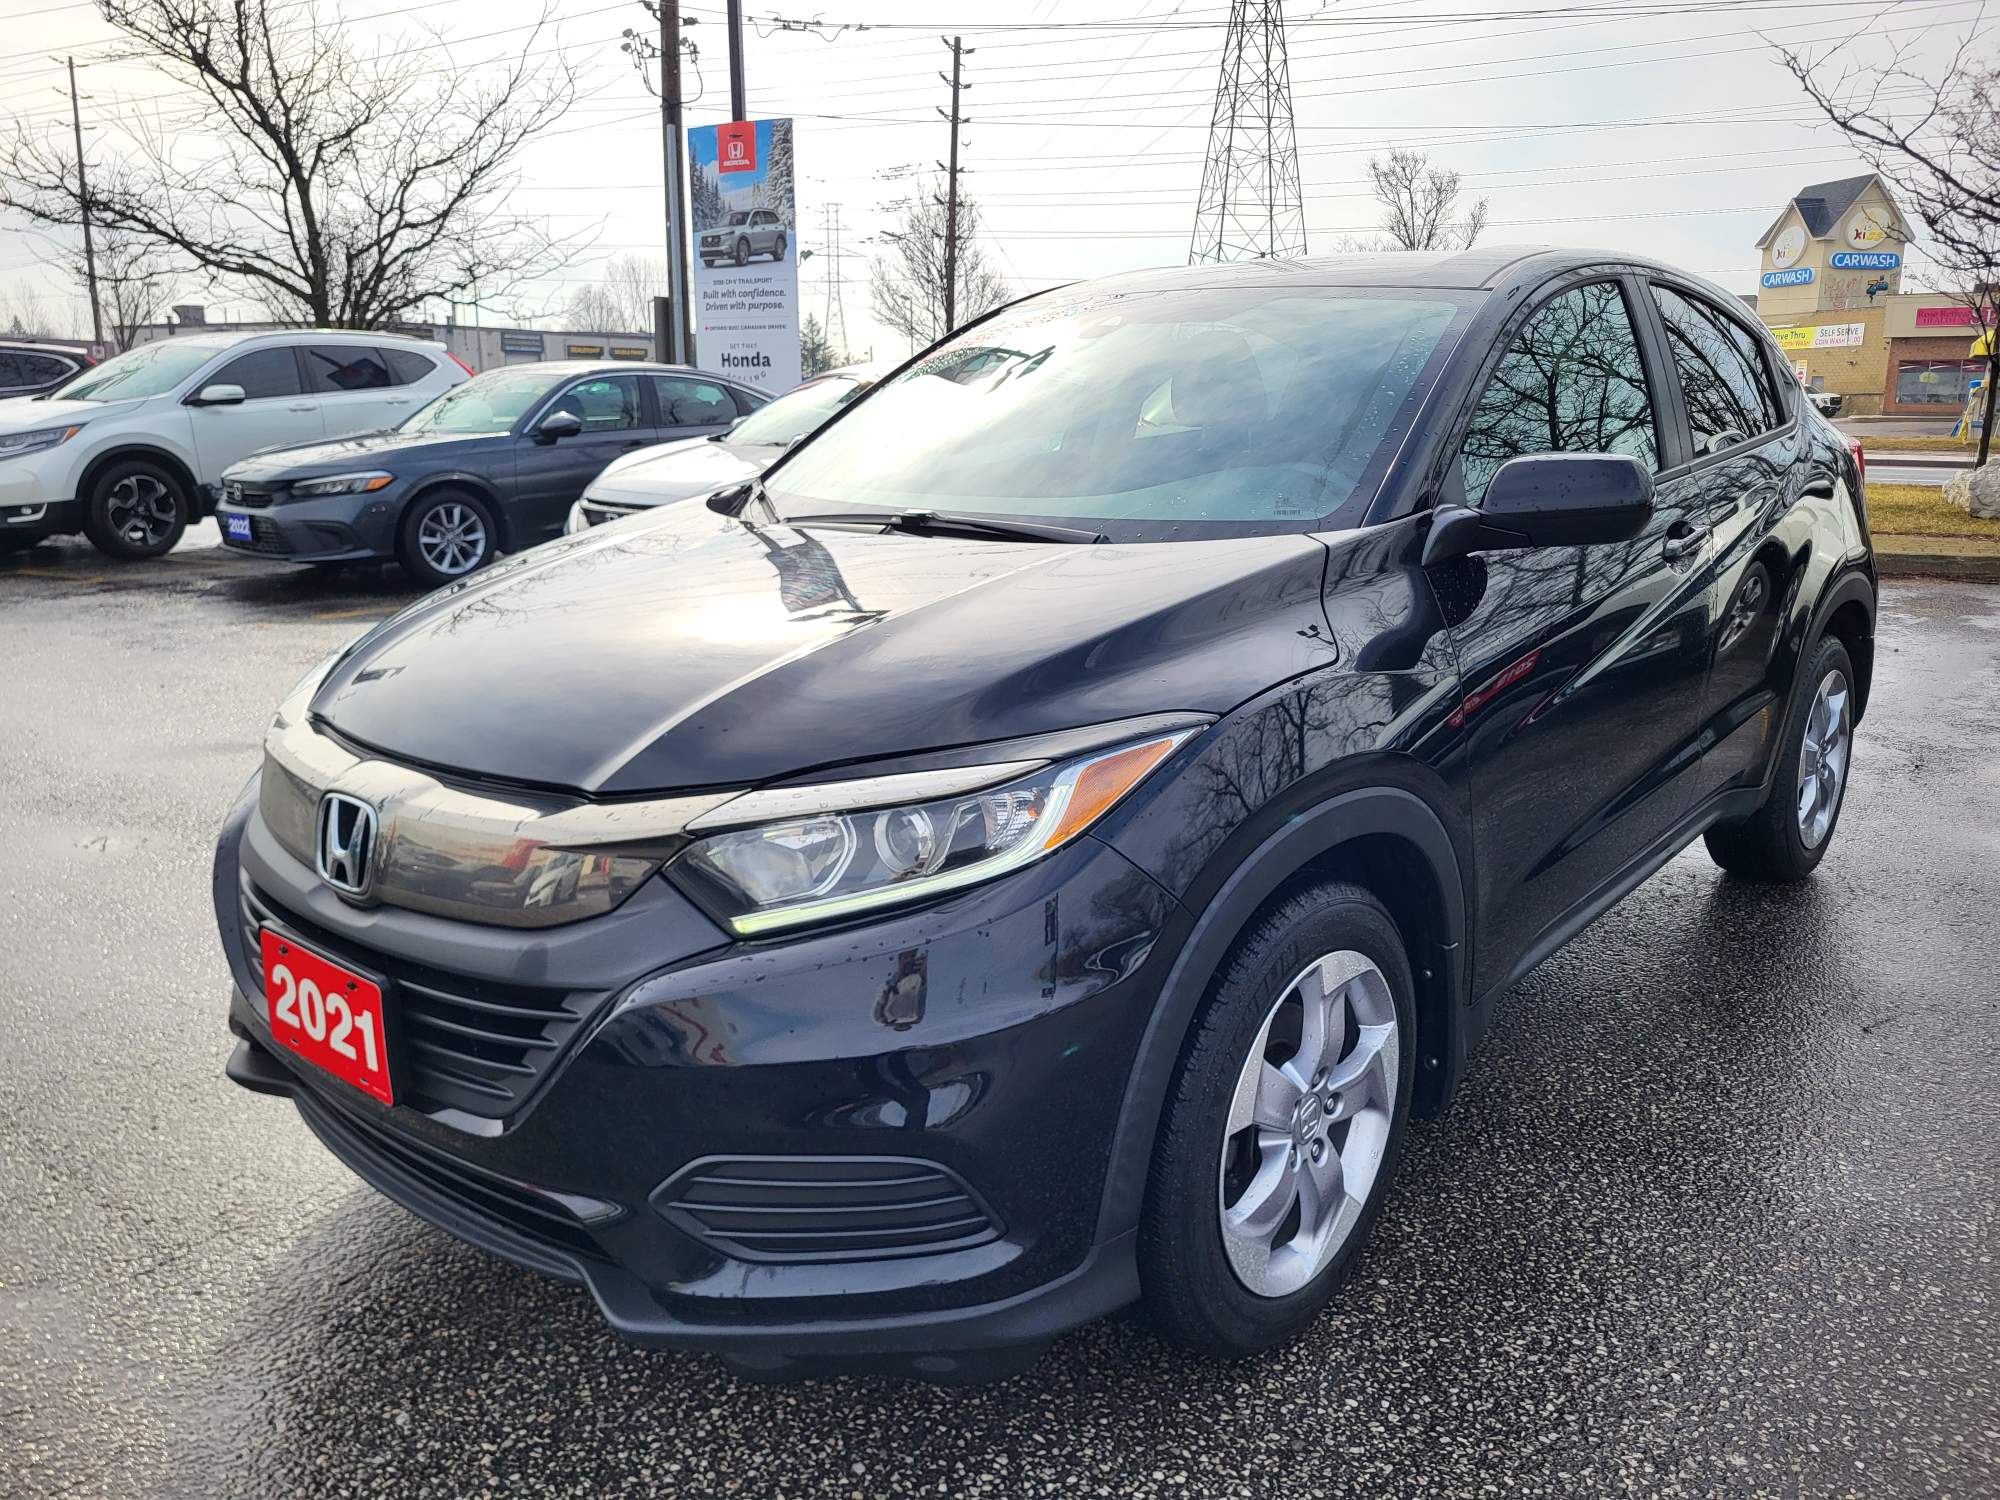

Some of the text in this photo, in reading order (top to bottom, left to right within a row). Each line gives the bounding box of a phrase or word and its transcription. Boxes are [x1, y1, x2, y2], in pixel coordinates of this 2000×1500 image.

[1834, 254, 1896, 267] CARWASH
[1763, 270, 1810, 287] CARWASH
[703, 288, 787, 299] Built with confidence.
[705, 301, 785, 312] Driven with purpose.
[1789, 331, 1806, 339] Thru
[1820, 328, 1836, 338] SELF
[721, 351, 772, 368] Honda
[228, 518, 249, 535] 2022
[271, 963, 379, 1072] 2021
